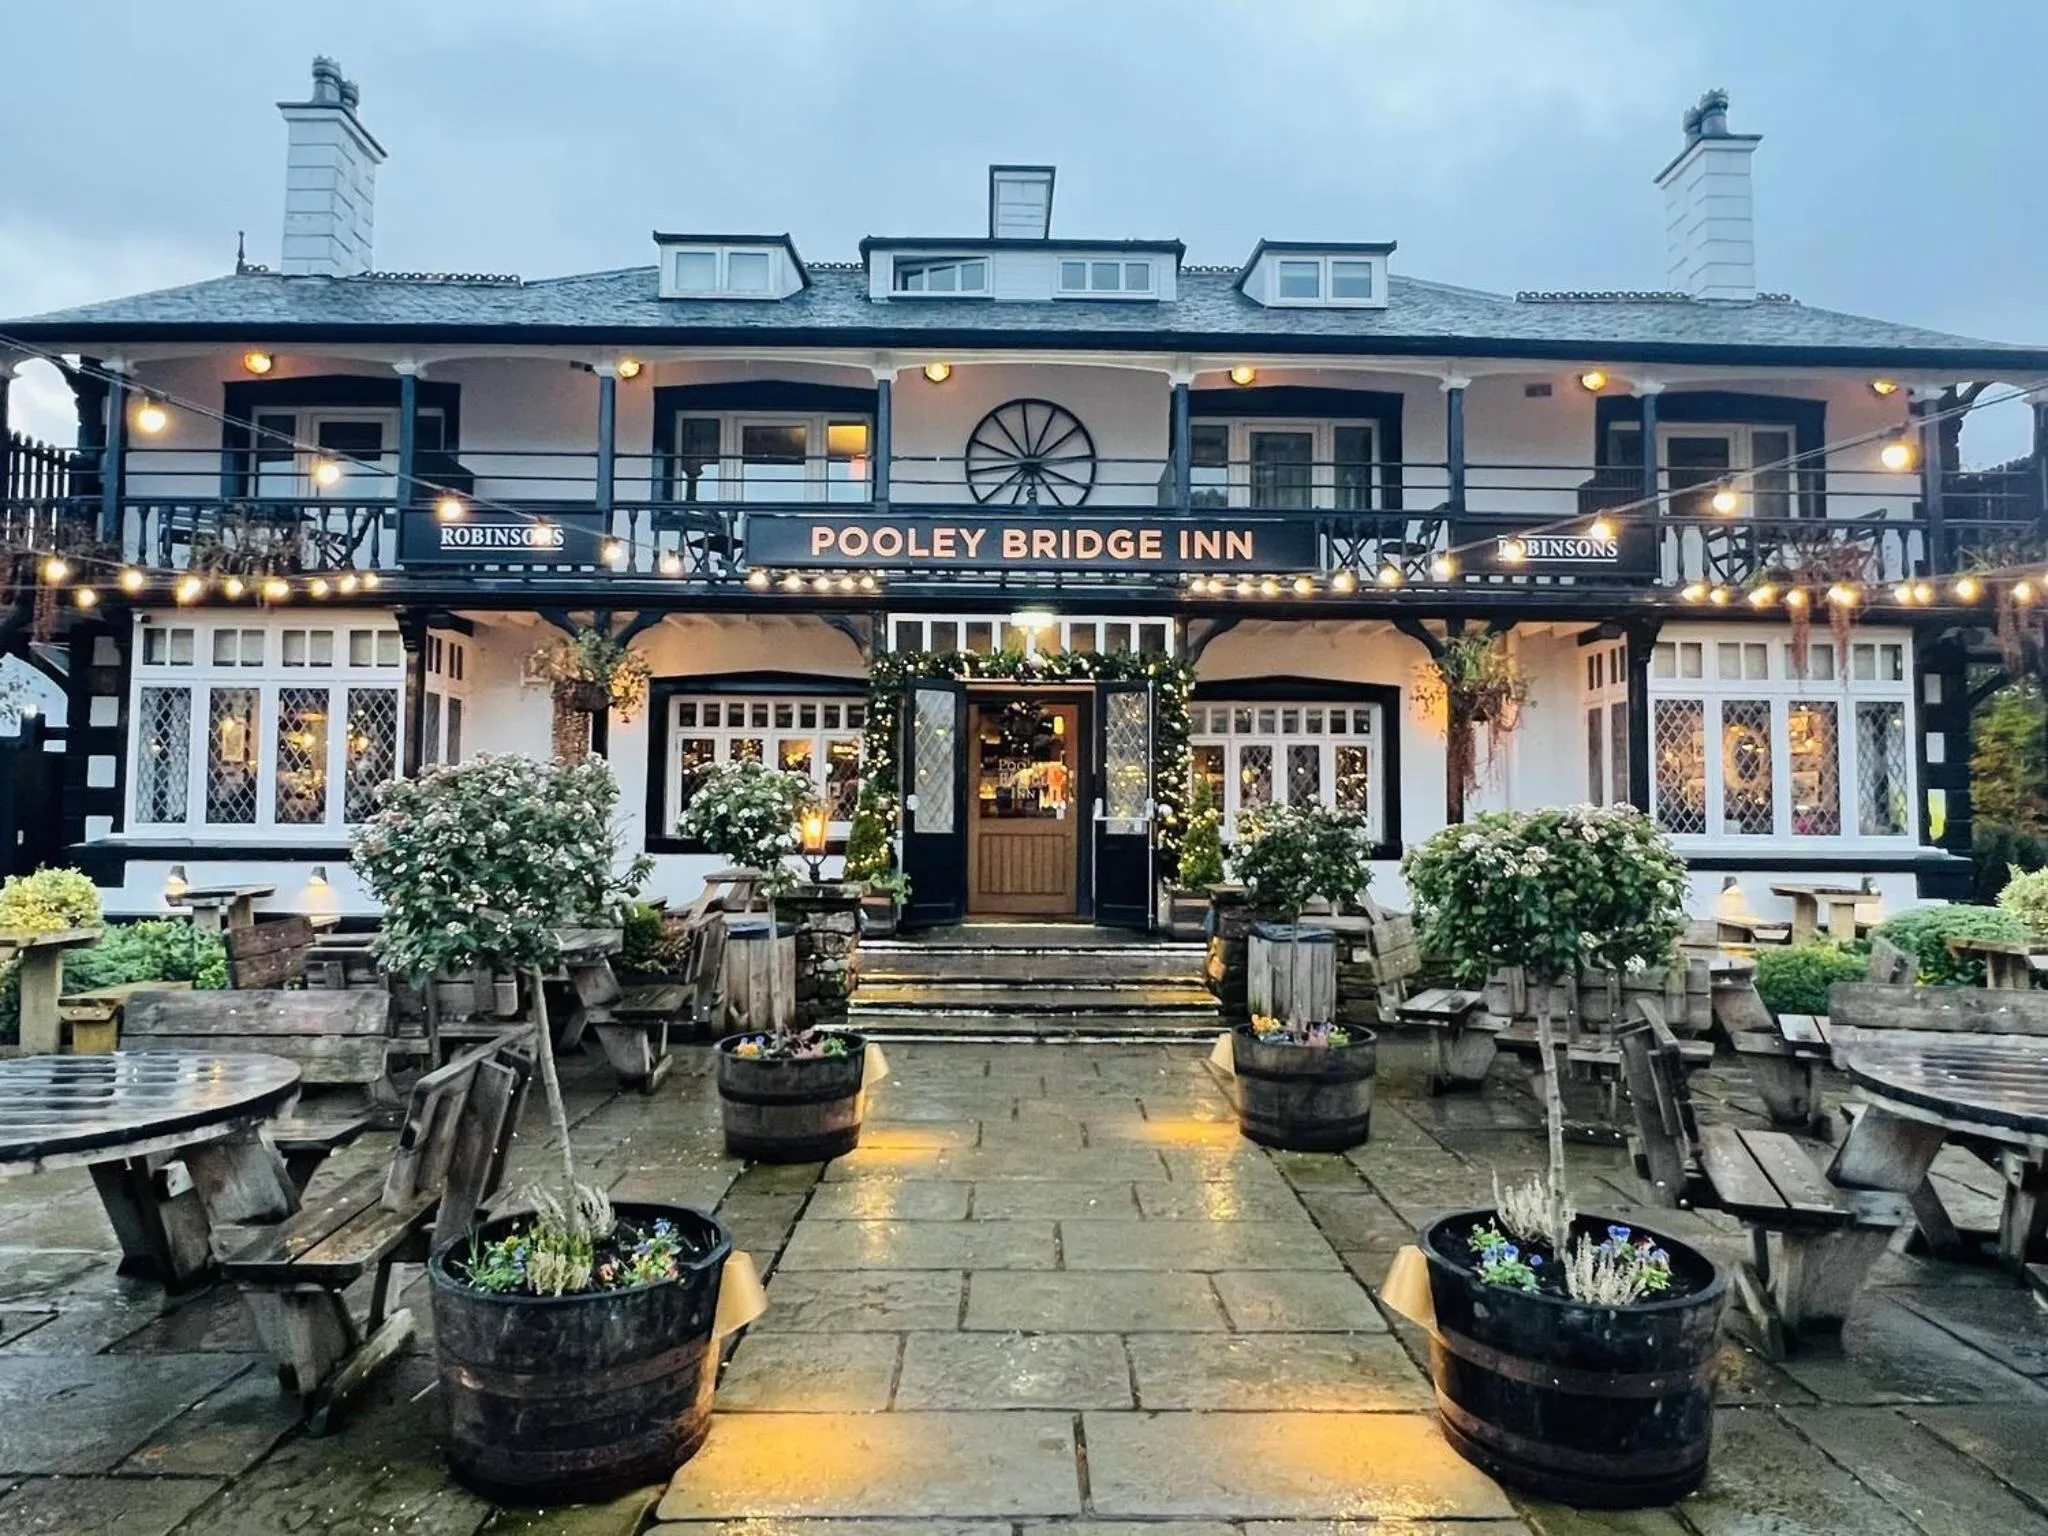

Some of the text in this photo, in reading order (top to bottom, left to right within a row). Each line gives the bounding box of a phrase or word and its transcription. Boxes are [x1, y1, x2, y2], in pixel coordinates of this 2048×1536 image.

[440, 527, 564, 546] ROBINSOS
[811, 526, 1253, 560] POOLEY BRIDGE INN
